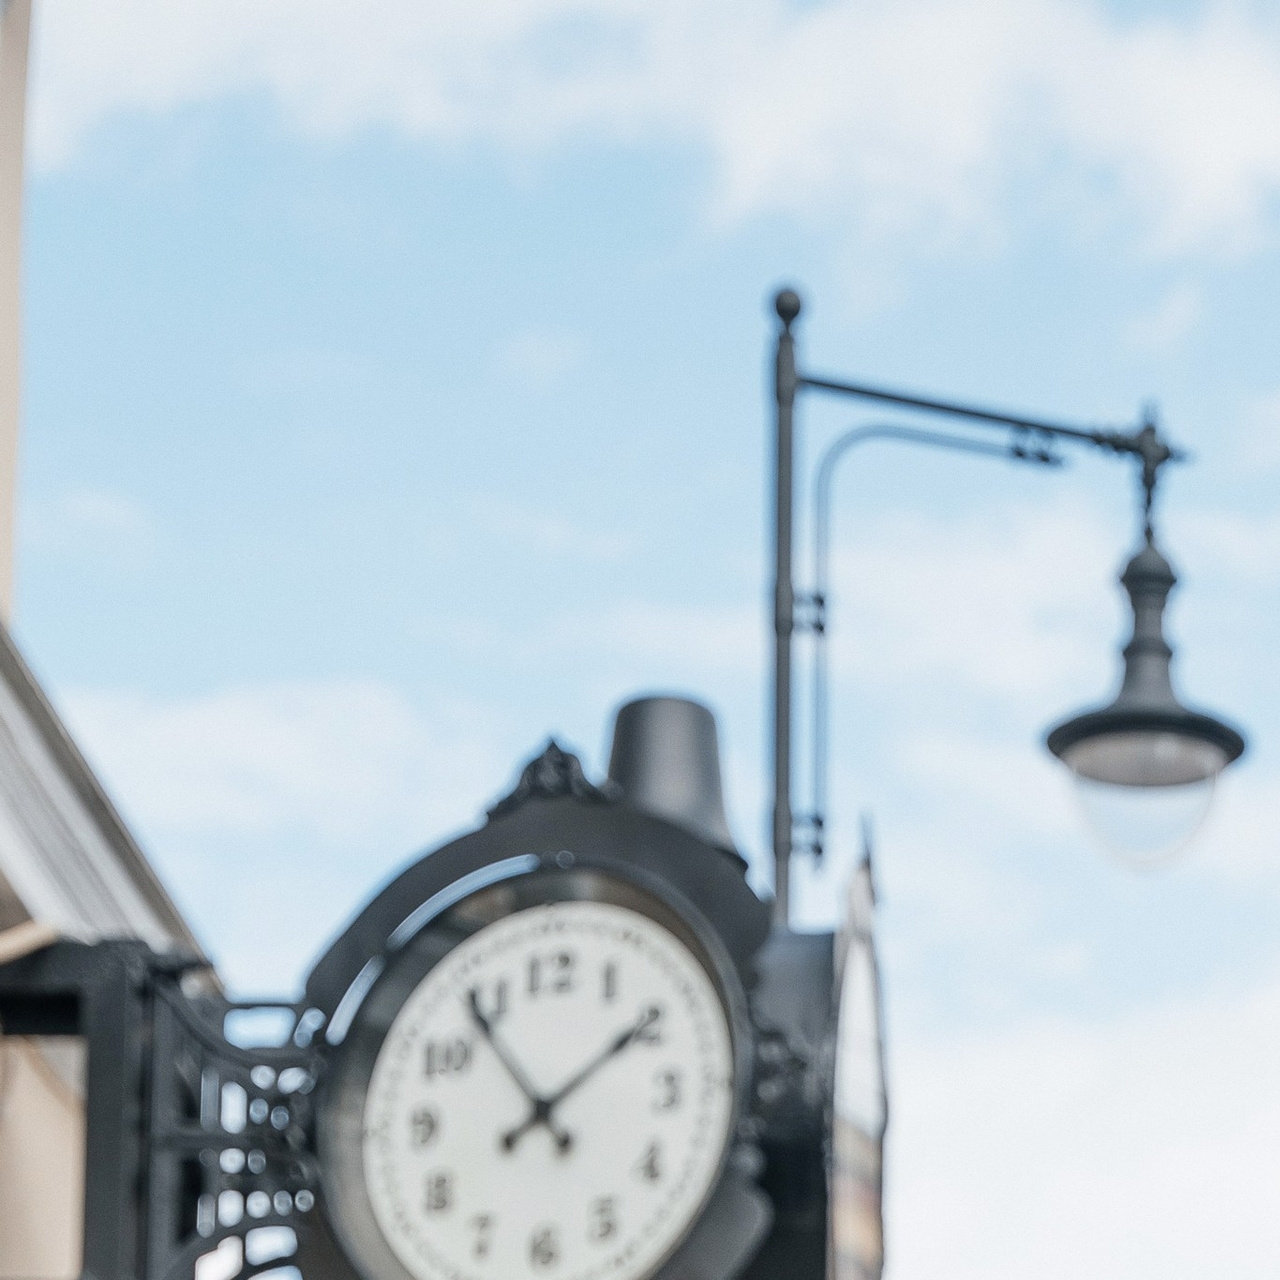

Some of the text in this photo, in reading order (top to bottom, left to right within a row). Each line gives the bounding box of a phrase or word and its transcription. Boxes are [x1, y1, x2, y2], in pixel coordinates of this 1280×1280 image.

[528, 951, 574, 996] 12
[602, 961, 617, 1000] 1
[422, 1040, 471, 1078] 10
[655, 1067, 681, 1111] 3
[409, 1106, 437, 1146] 9
[635, 1139, 662, 1181] 4
[529, 1226, 560, 1270] 6
